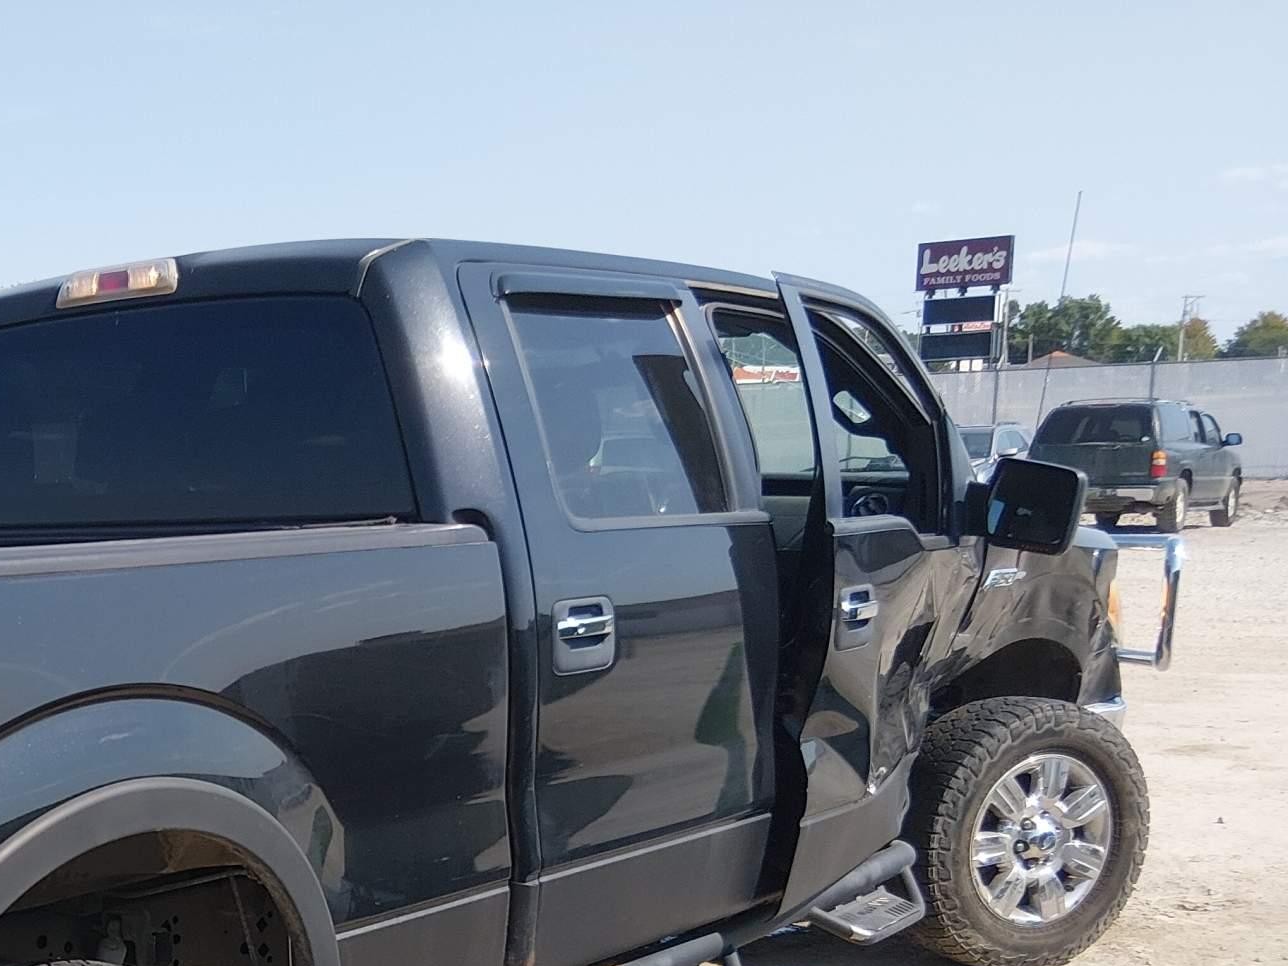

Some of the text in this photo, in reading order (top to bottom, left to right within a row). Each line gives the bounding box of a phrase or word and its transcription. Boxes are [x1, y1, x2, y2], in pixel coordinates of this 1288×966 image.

[920, 246, 1007, 274] Leeker's
[923, 272, 1001, 286] FAMILY FOODS
